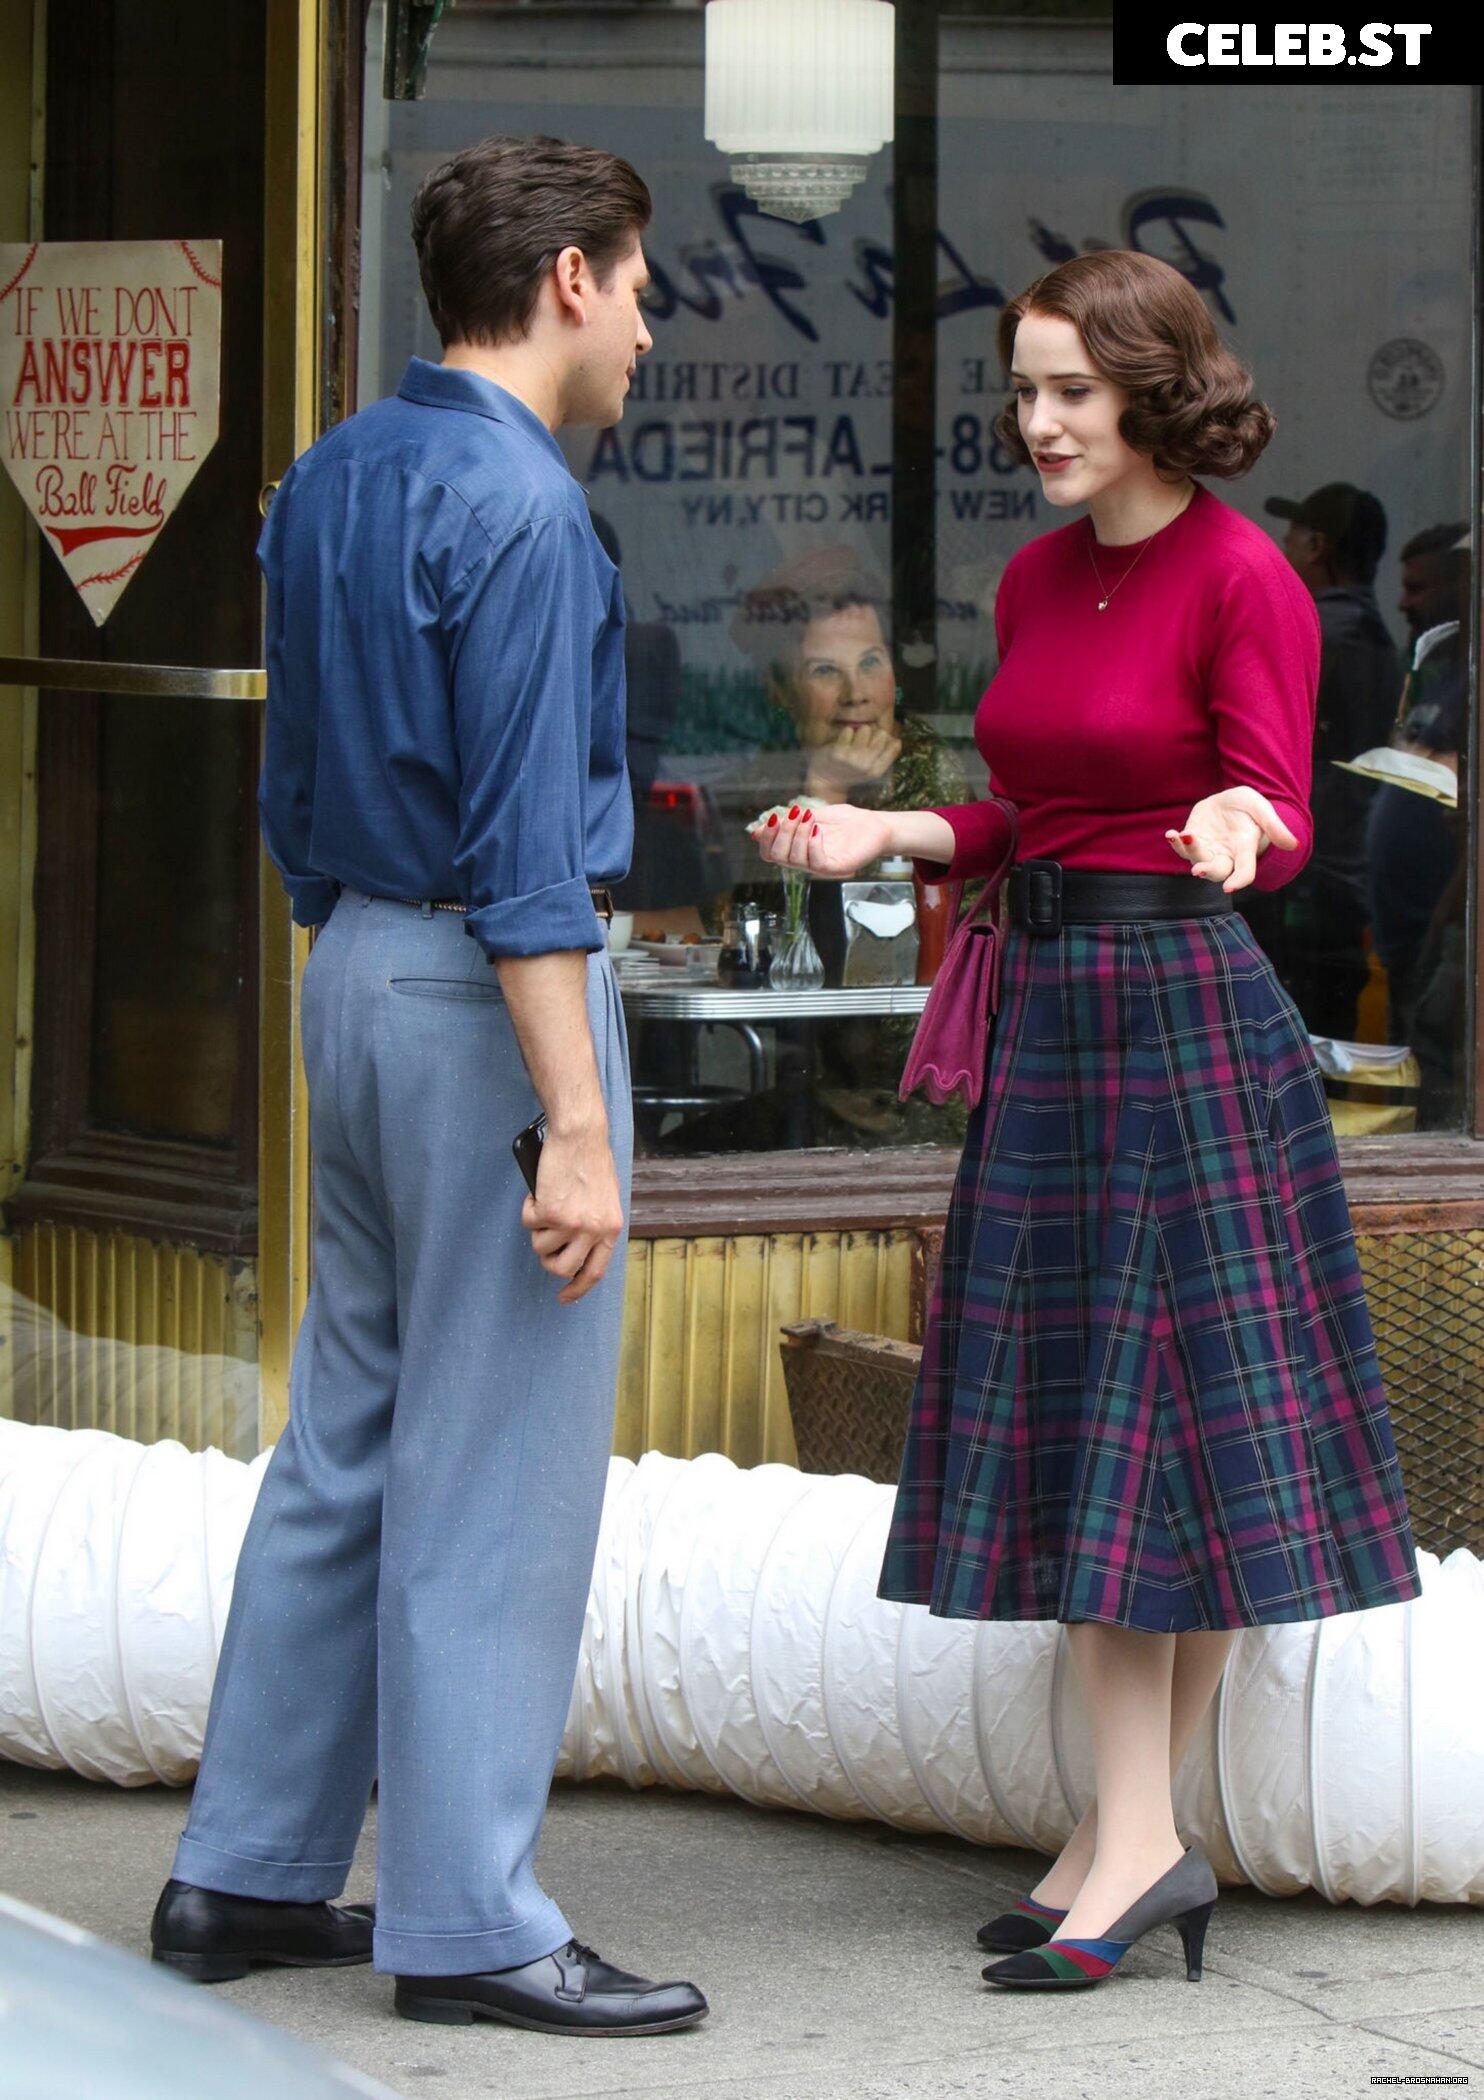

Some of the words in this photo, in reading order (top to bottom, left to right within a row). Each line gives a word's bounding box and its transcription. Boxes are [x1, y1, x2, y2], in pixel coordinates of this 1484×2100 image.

[15, 286, 44, 336] IF
[56, 286, 101, 336] WE
[114, 286, 199, 337] DONT
[14, 338, 191, 408] ANSWER
[96, 410, 134, 460] AT
[138, 410, 198, 462] THE
[36, 463, 98, 517] Ball
[104, 463, 168, 517] Field
